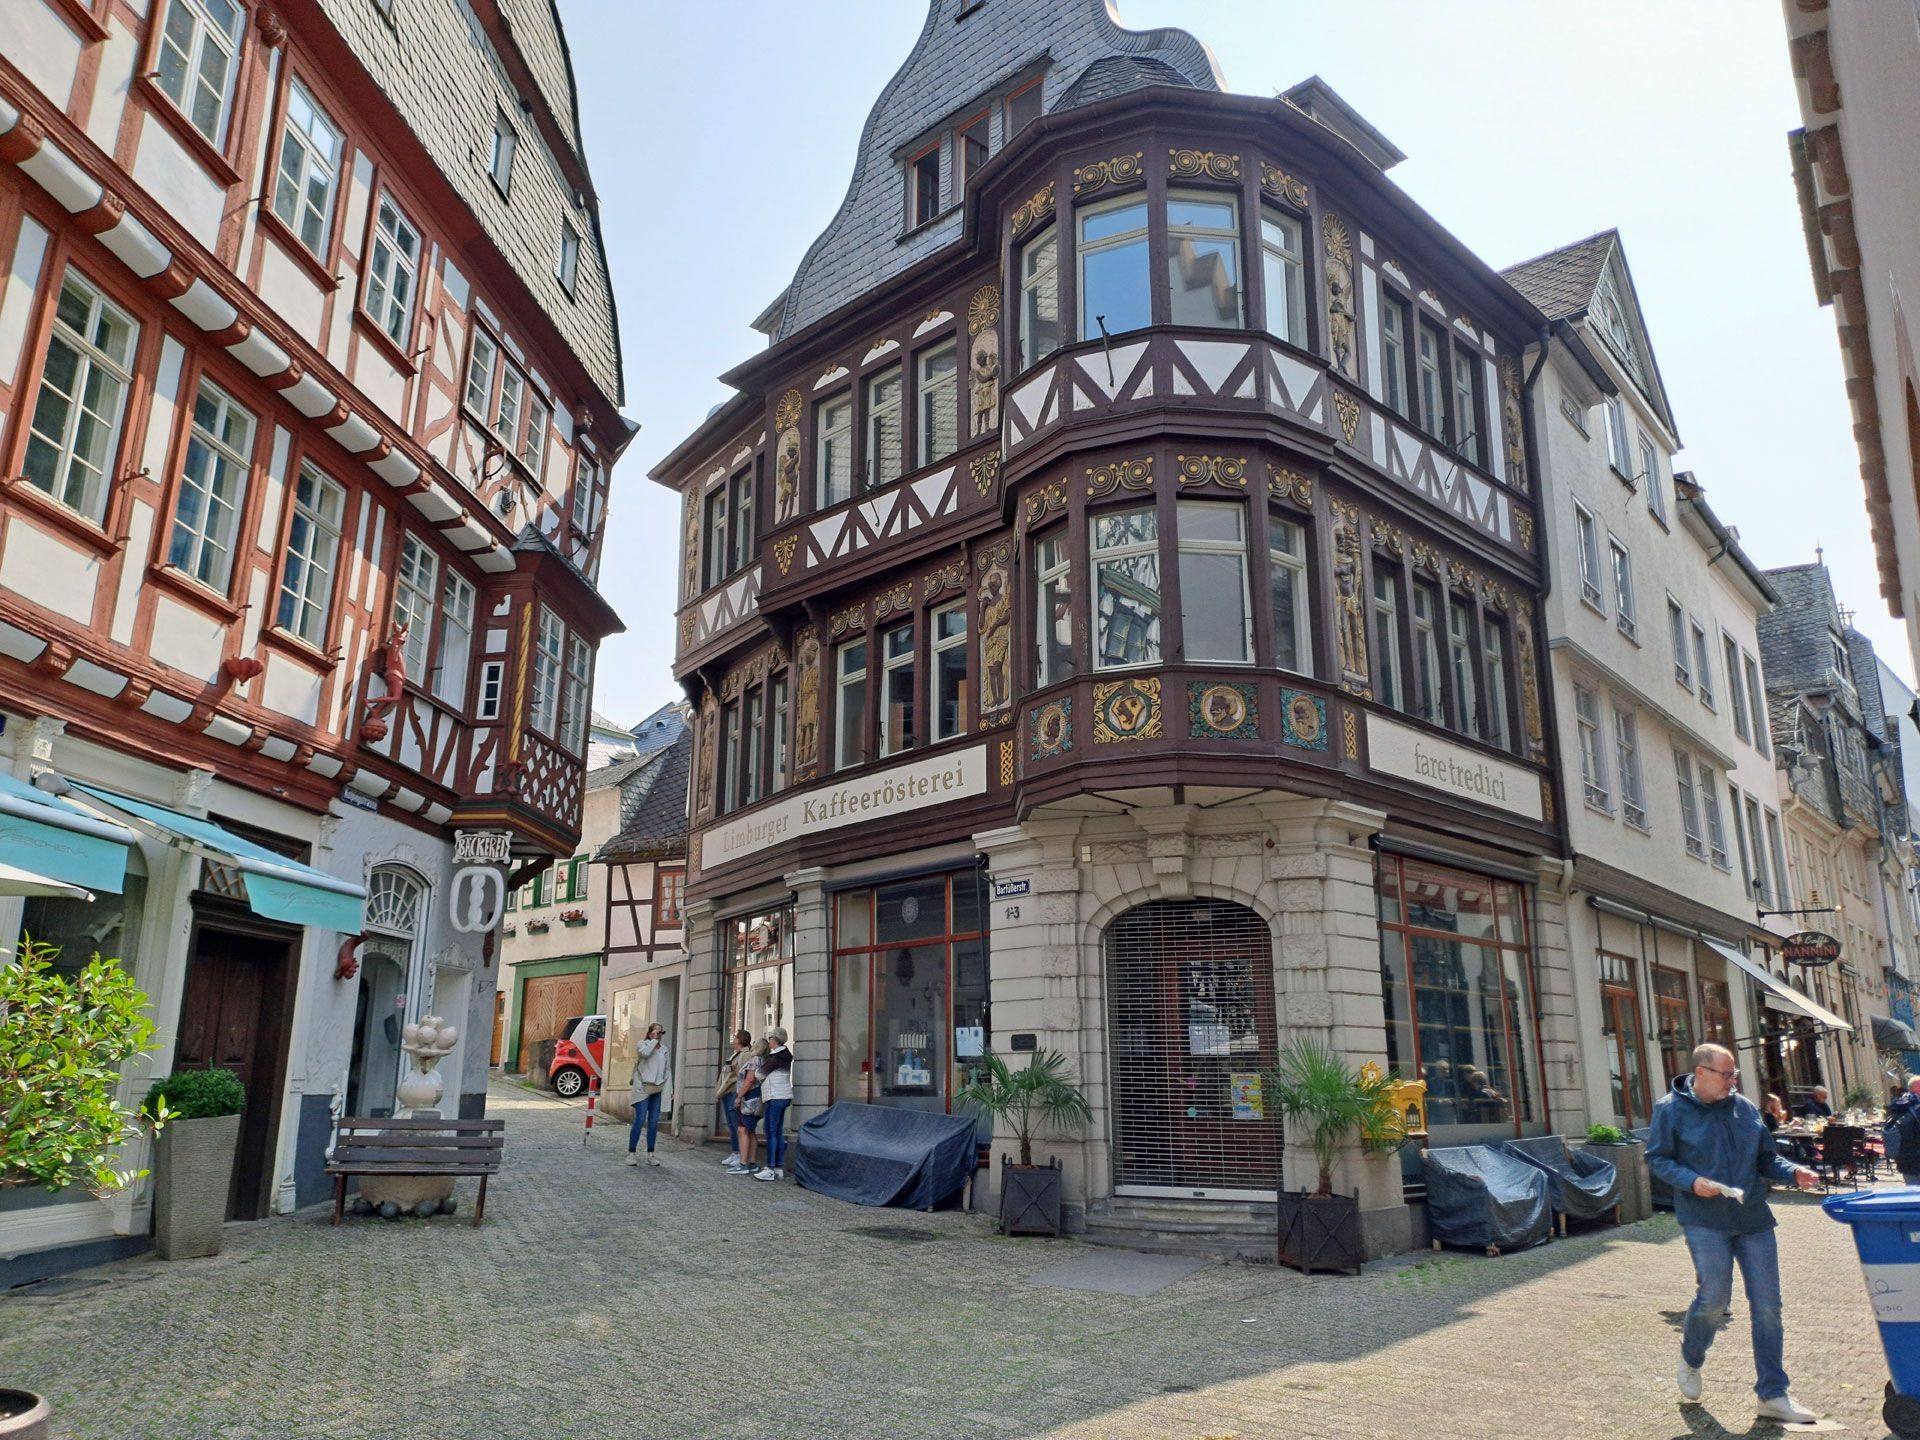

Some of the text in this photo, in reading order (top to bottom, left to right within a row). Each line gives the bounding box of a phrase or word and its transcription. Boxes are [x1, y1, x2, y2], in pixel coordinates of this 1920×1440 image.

[723, 760, 965, 852] Limburger Kaffeerösterei
[458, 836, 506, 858] BÄCKEREI
[996, 881, 1028, 895] Barfüßerstr.
[1783, 944, 1837, 957] NANNINI
